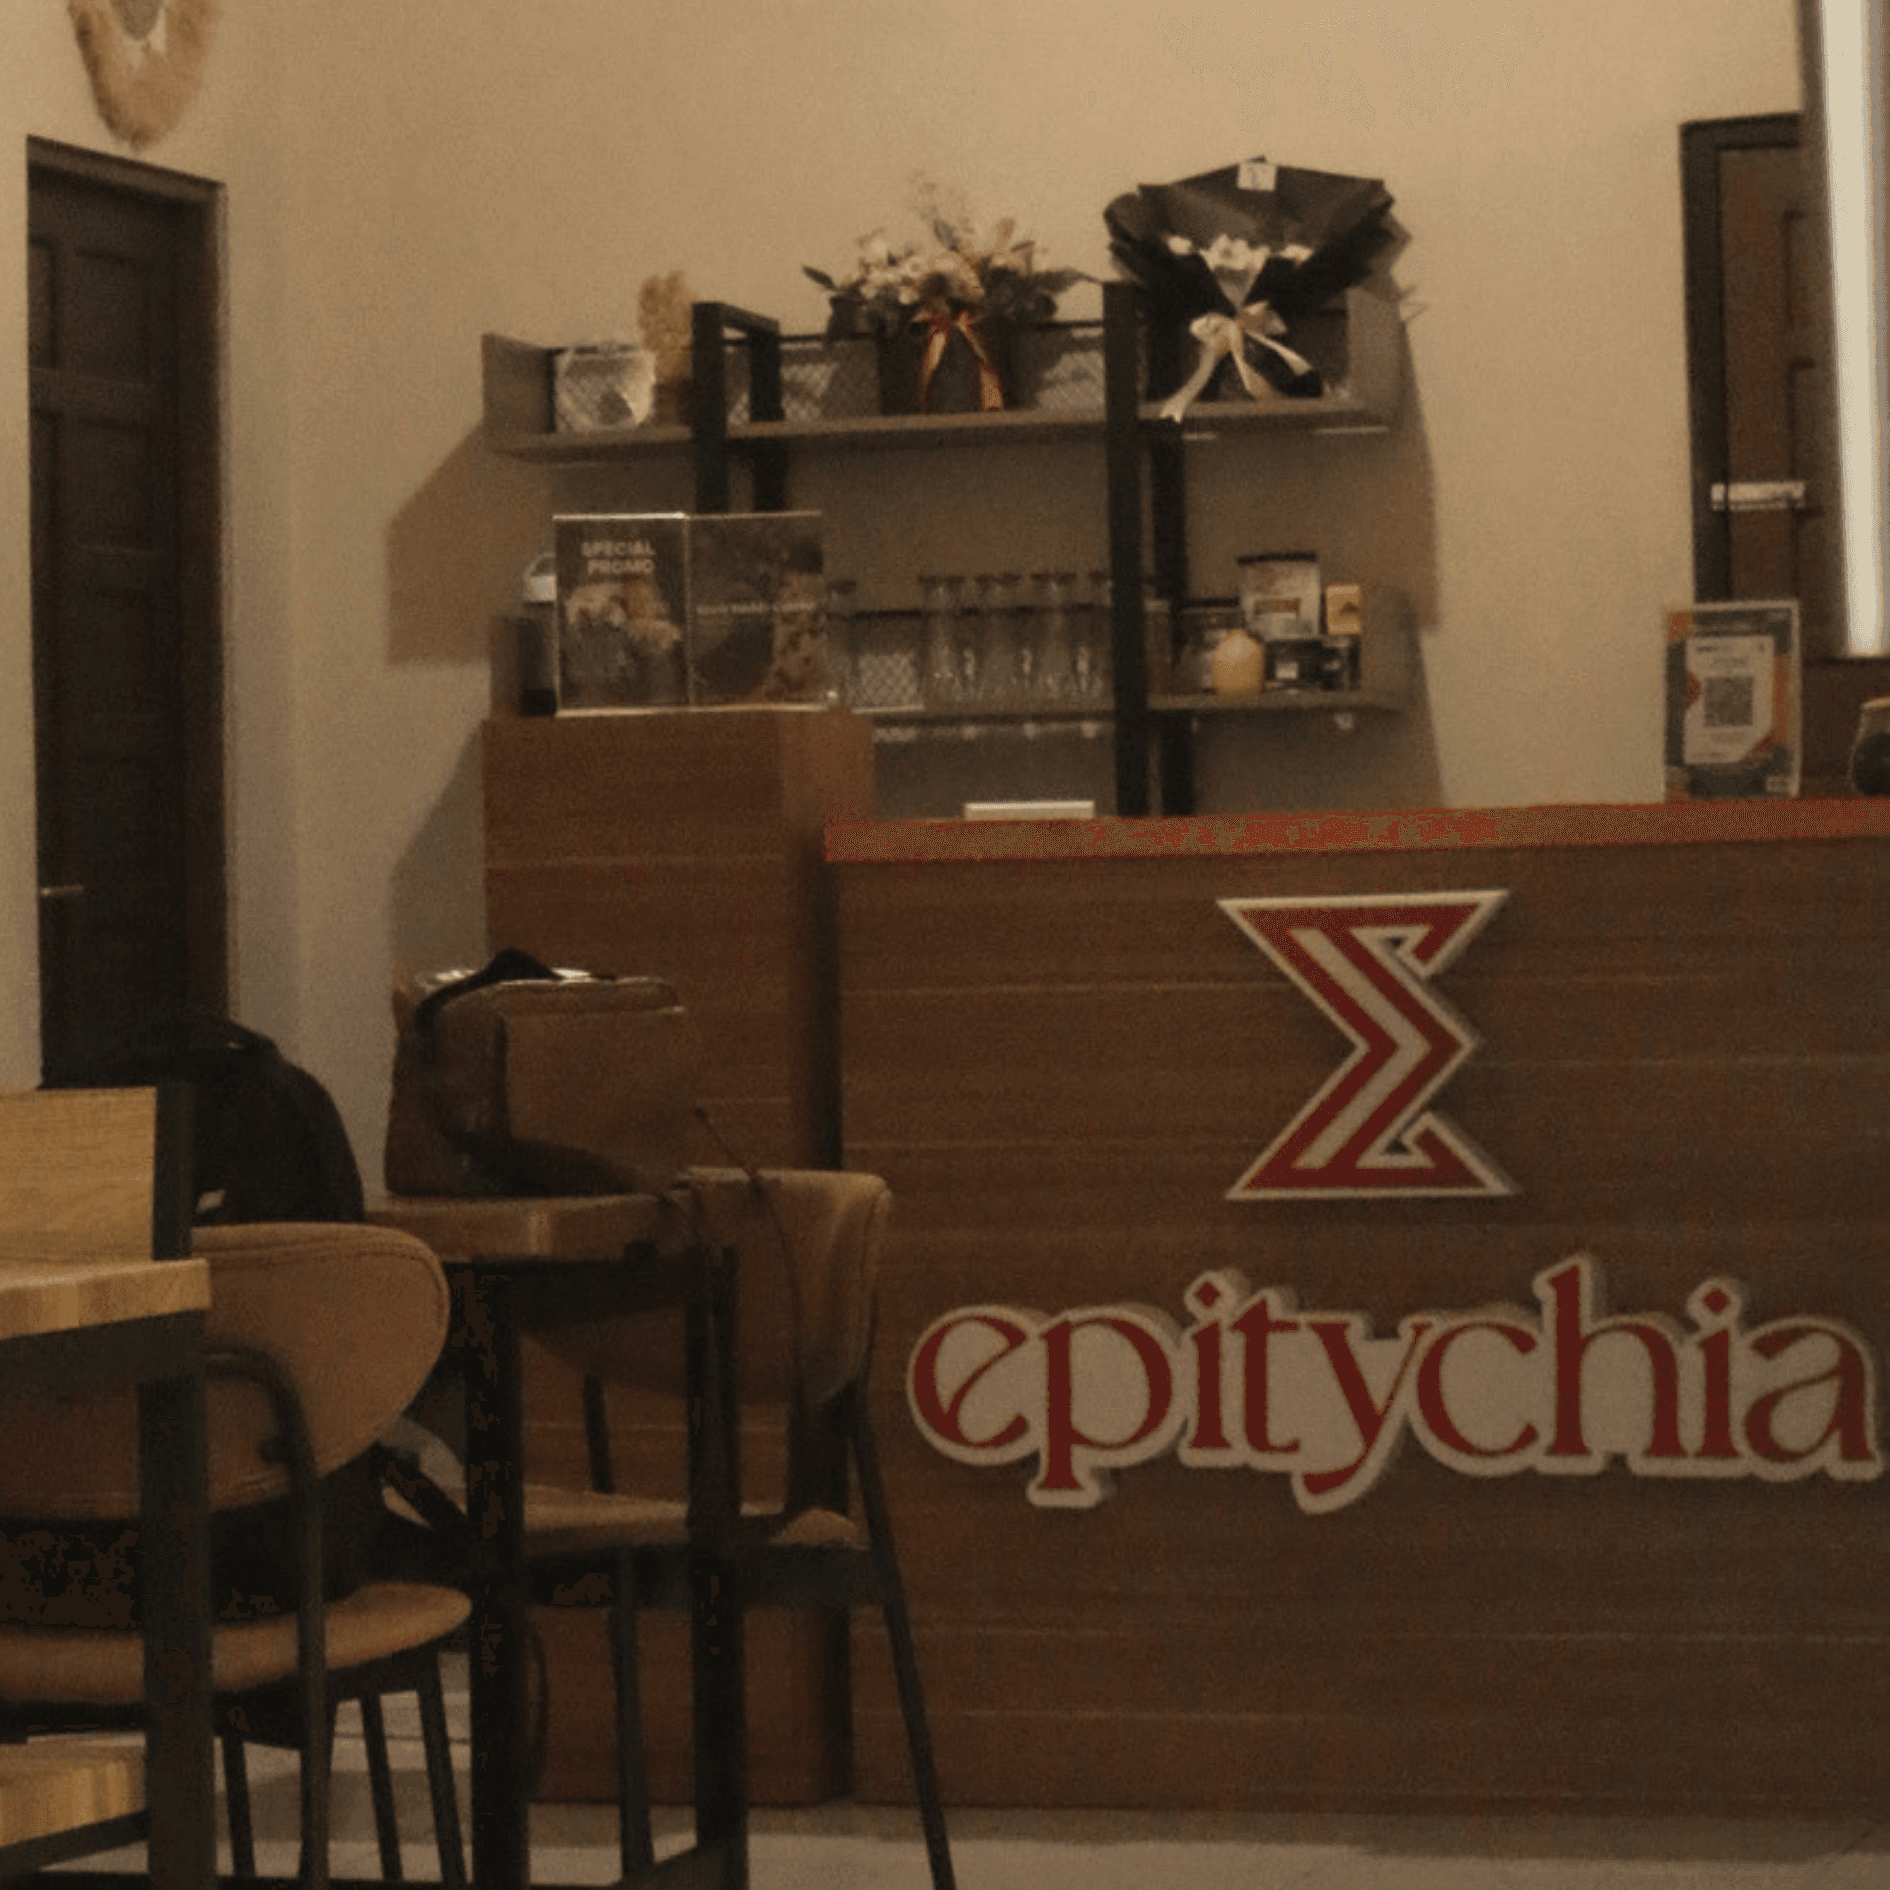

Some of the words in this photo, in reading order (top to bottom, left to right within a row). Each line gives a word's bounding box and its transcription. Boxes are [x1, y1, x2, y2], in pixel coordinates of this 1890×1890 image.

[581, 540, 655, 557] SPECIAL
[588, 559, 654, 575] PROMO
[909, 1255, 1884, 1511] epitychia
